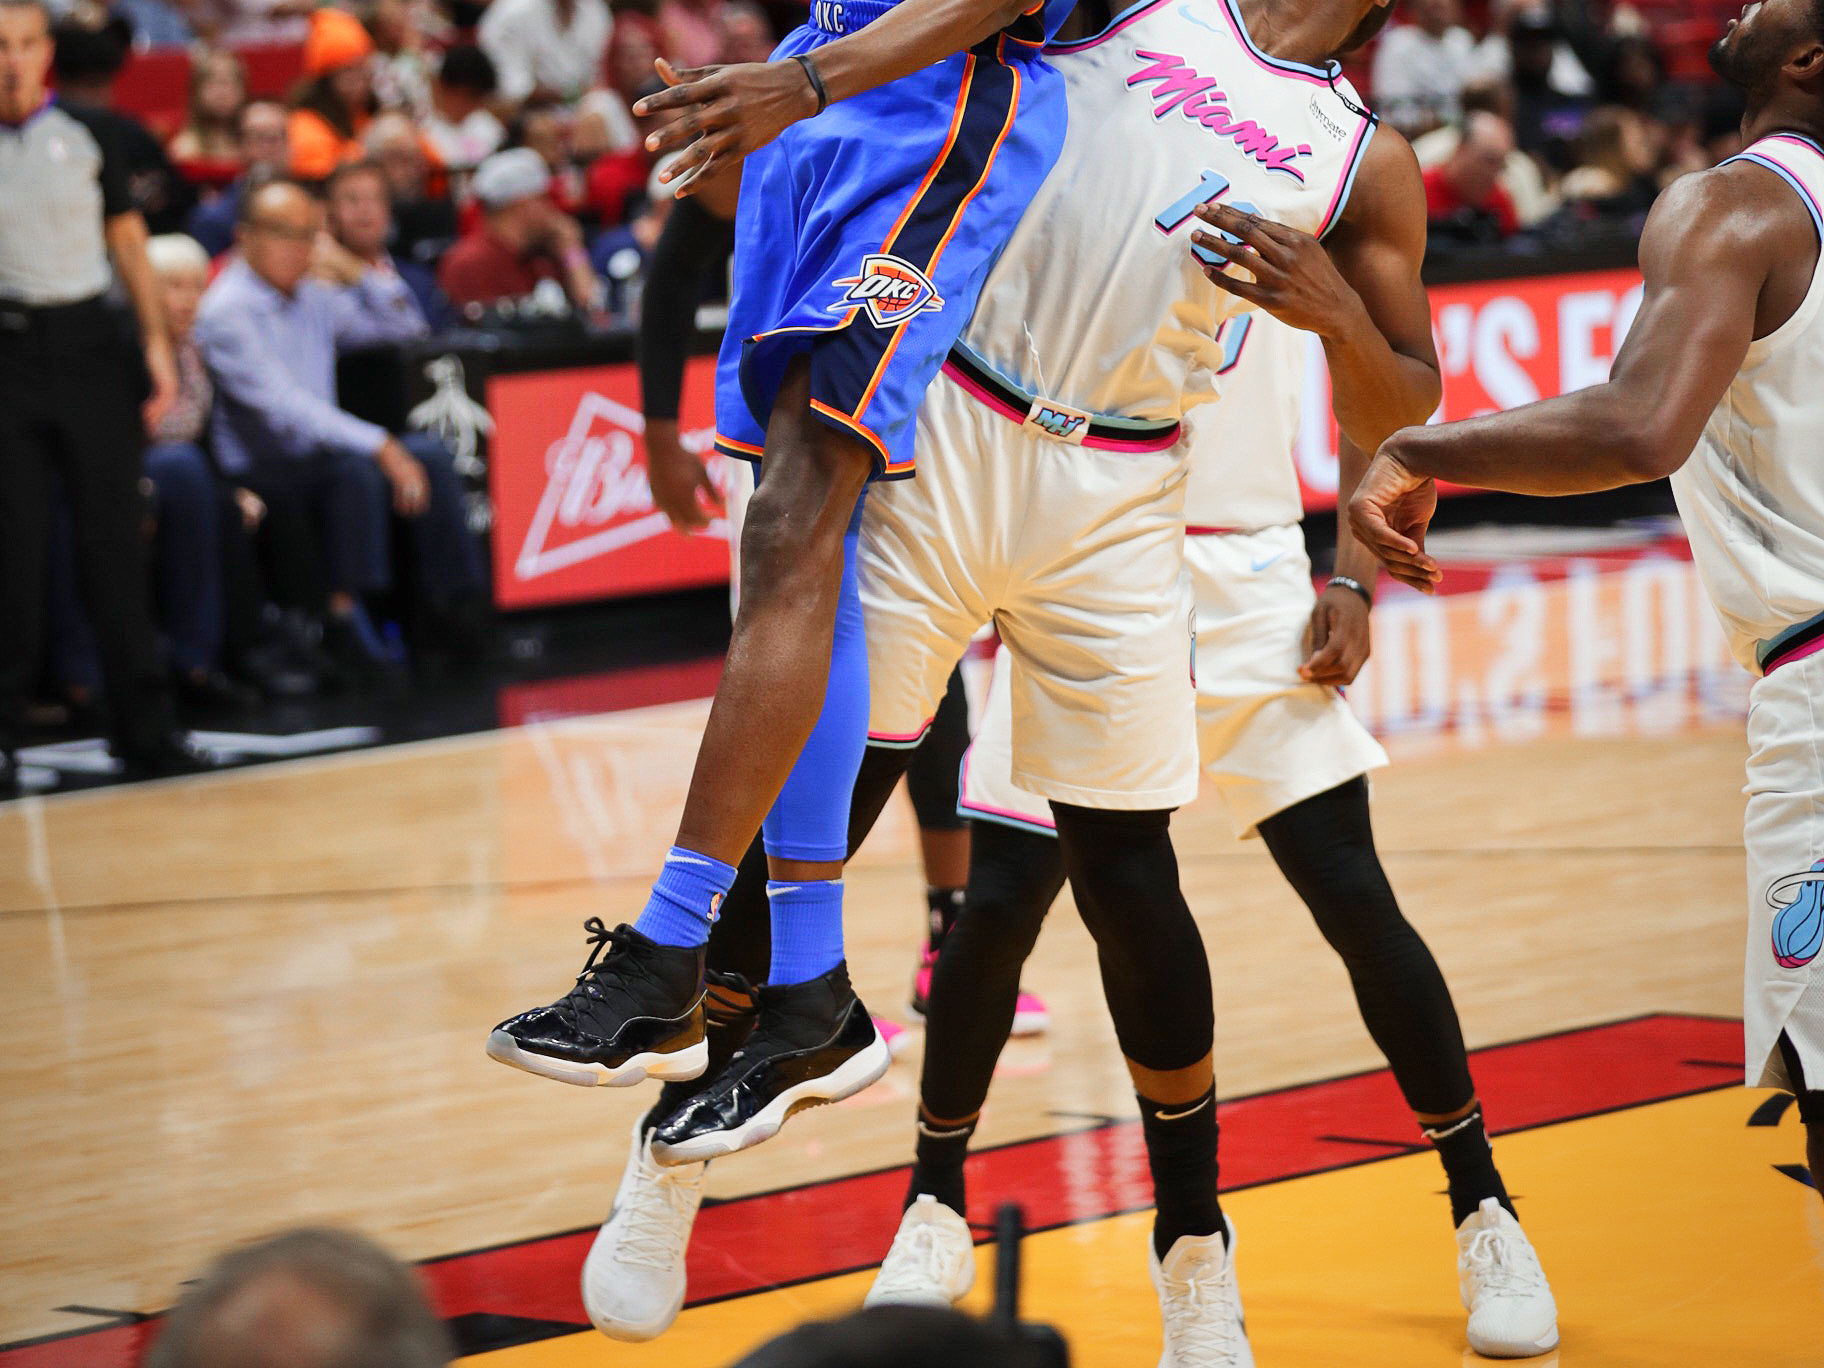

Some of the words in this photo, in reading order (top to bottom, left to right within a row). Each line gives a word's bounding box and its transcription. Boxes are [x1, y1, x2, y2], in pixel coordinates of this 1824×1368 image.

[815, 0, 845, 34] OKC
[1124, 48, 1314, 187] Miami
[848, 273, 921, 299] OKC
